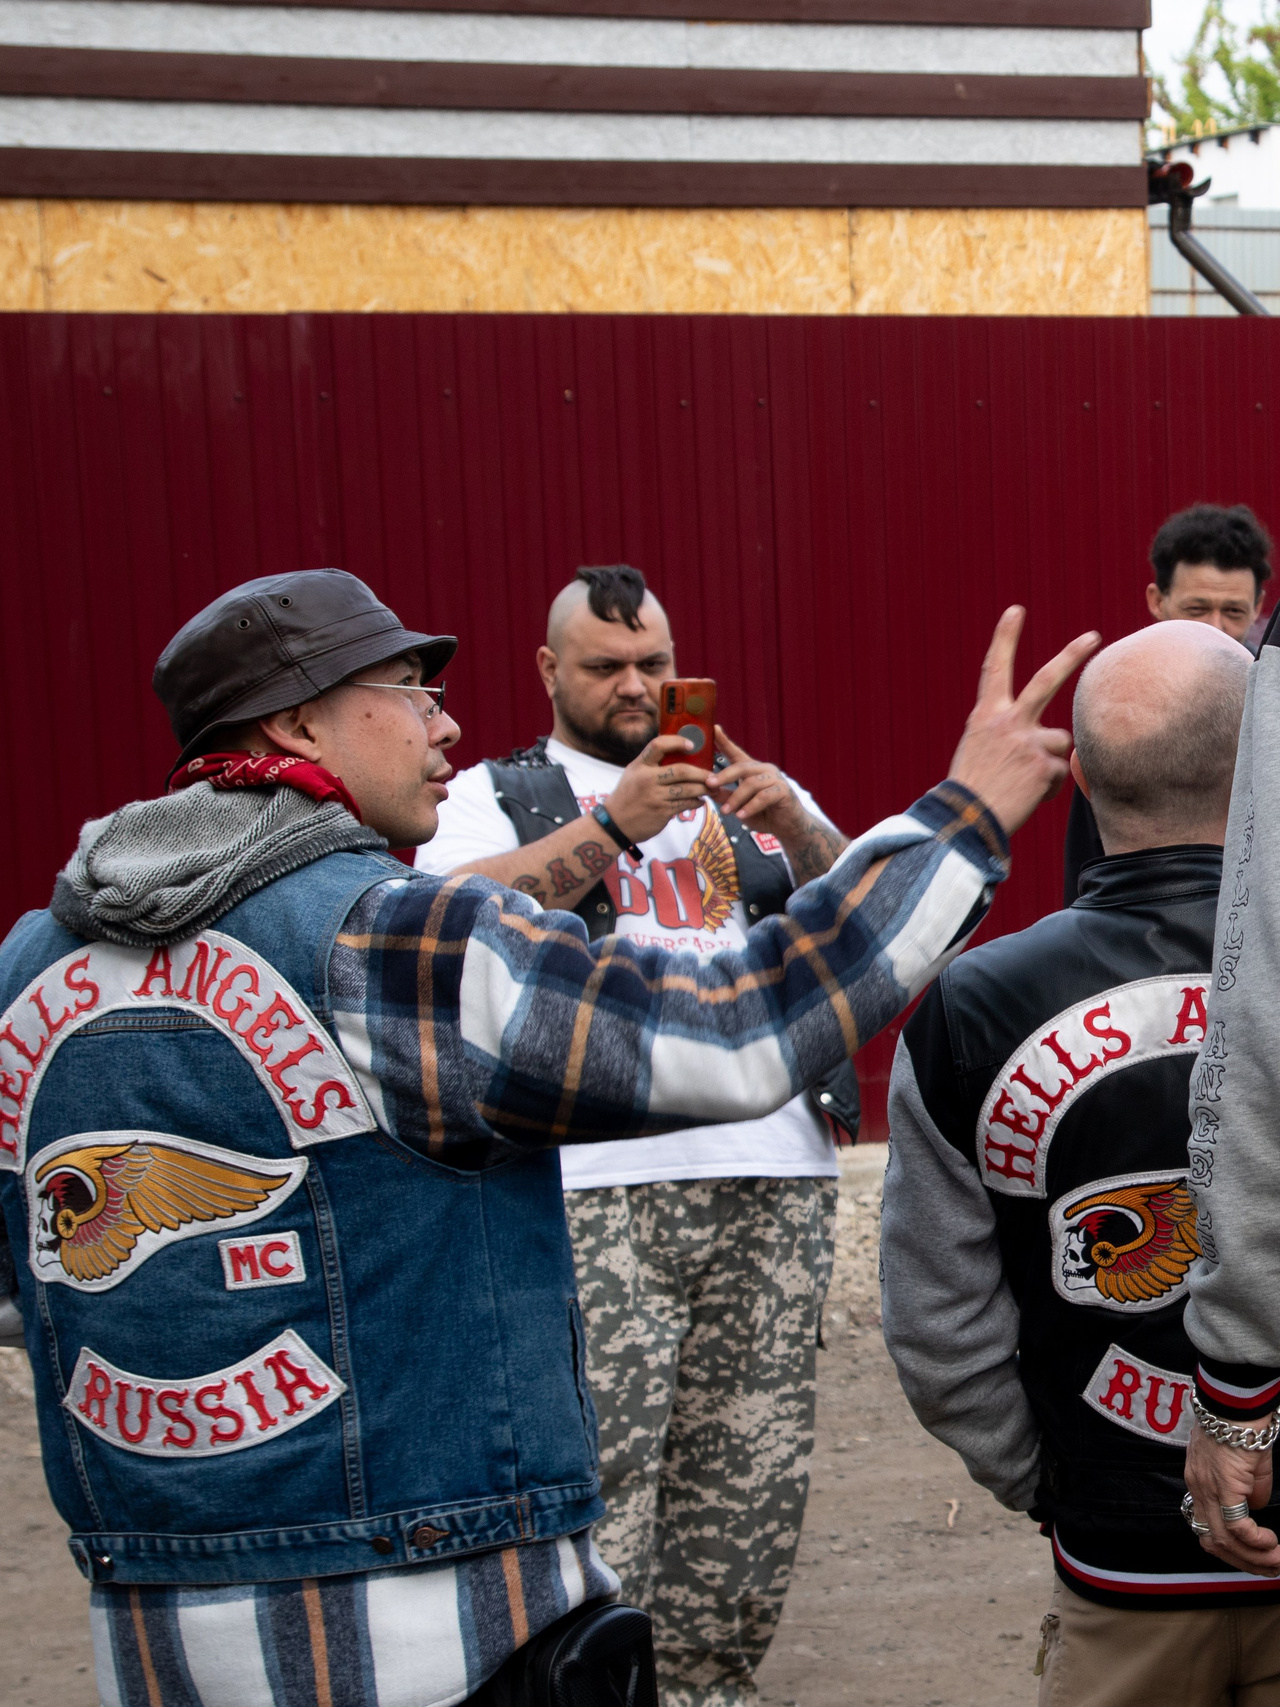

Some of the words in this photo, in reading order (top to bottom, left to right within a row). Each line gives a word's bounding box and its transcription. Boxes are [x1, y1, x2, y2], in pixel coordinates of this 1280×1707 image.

[1217, 786, 1255, 992] LLS
[133, 941, 355, 1129] ANGELS
[984, 1002, 1132, 1187] HELLS
[228, 1241, 294, 1282] MC
[78, 1349, 330, 1448] RUSSIA
